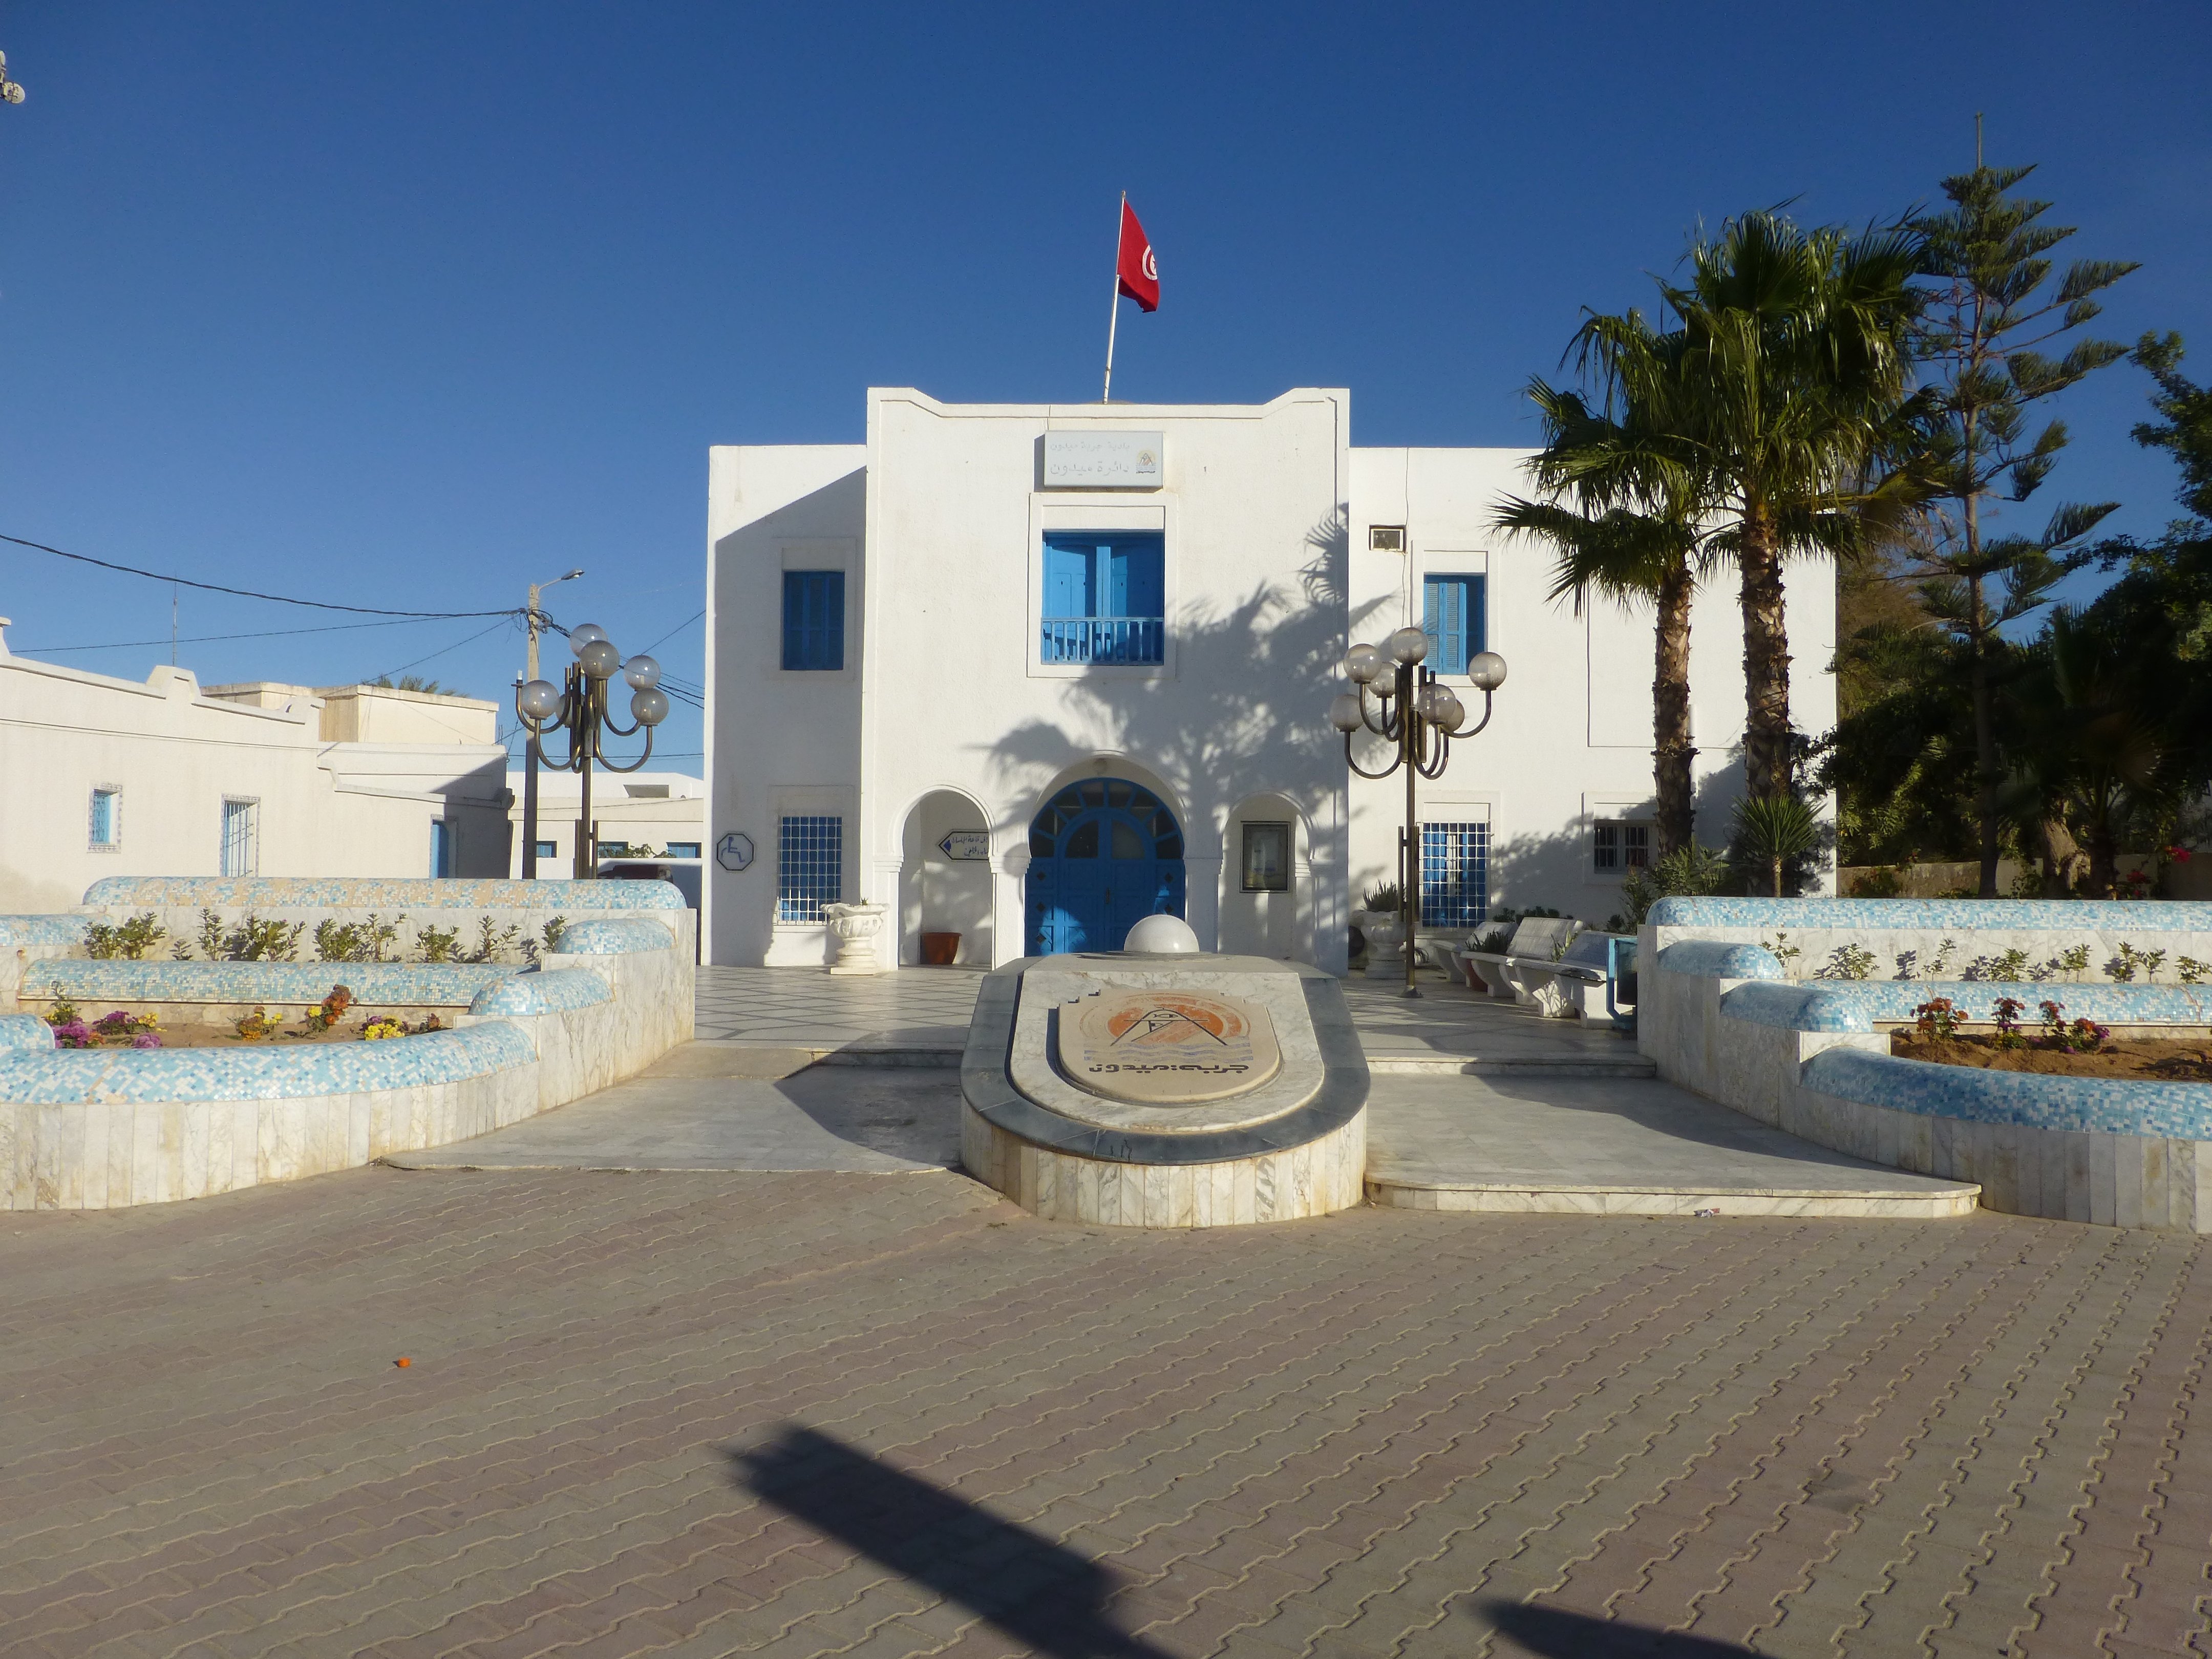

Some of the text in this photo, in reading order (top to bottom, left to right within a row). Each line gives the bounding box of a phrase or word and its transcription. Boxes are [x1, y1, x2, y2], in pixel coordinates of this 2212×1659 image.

[1050, 442, 1078, 451] ميدون
[1081, 441, 1102, 452] جربة
[1050, 461, 1129, 476] دائرة ميدون
